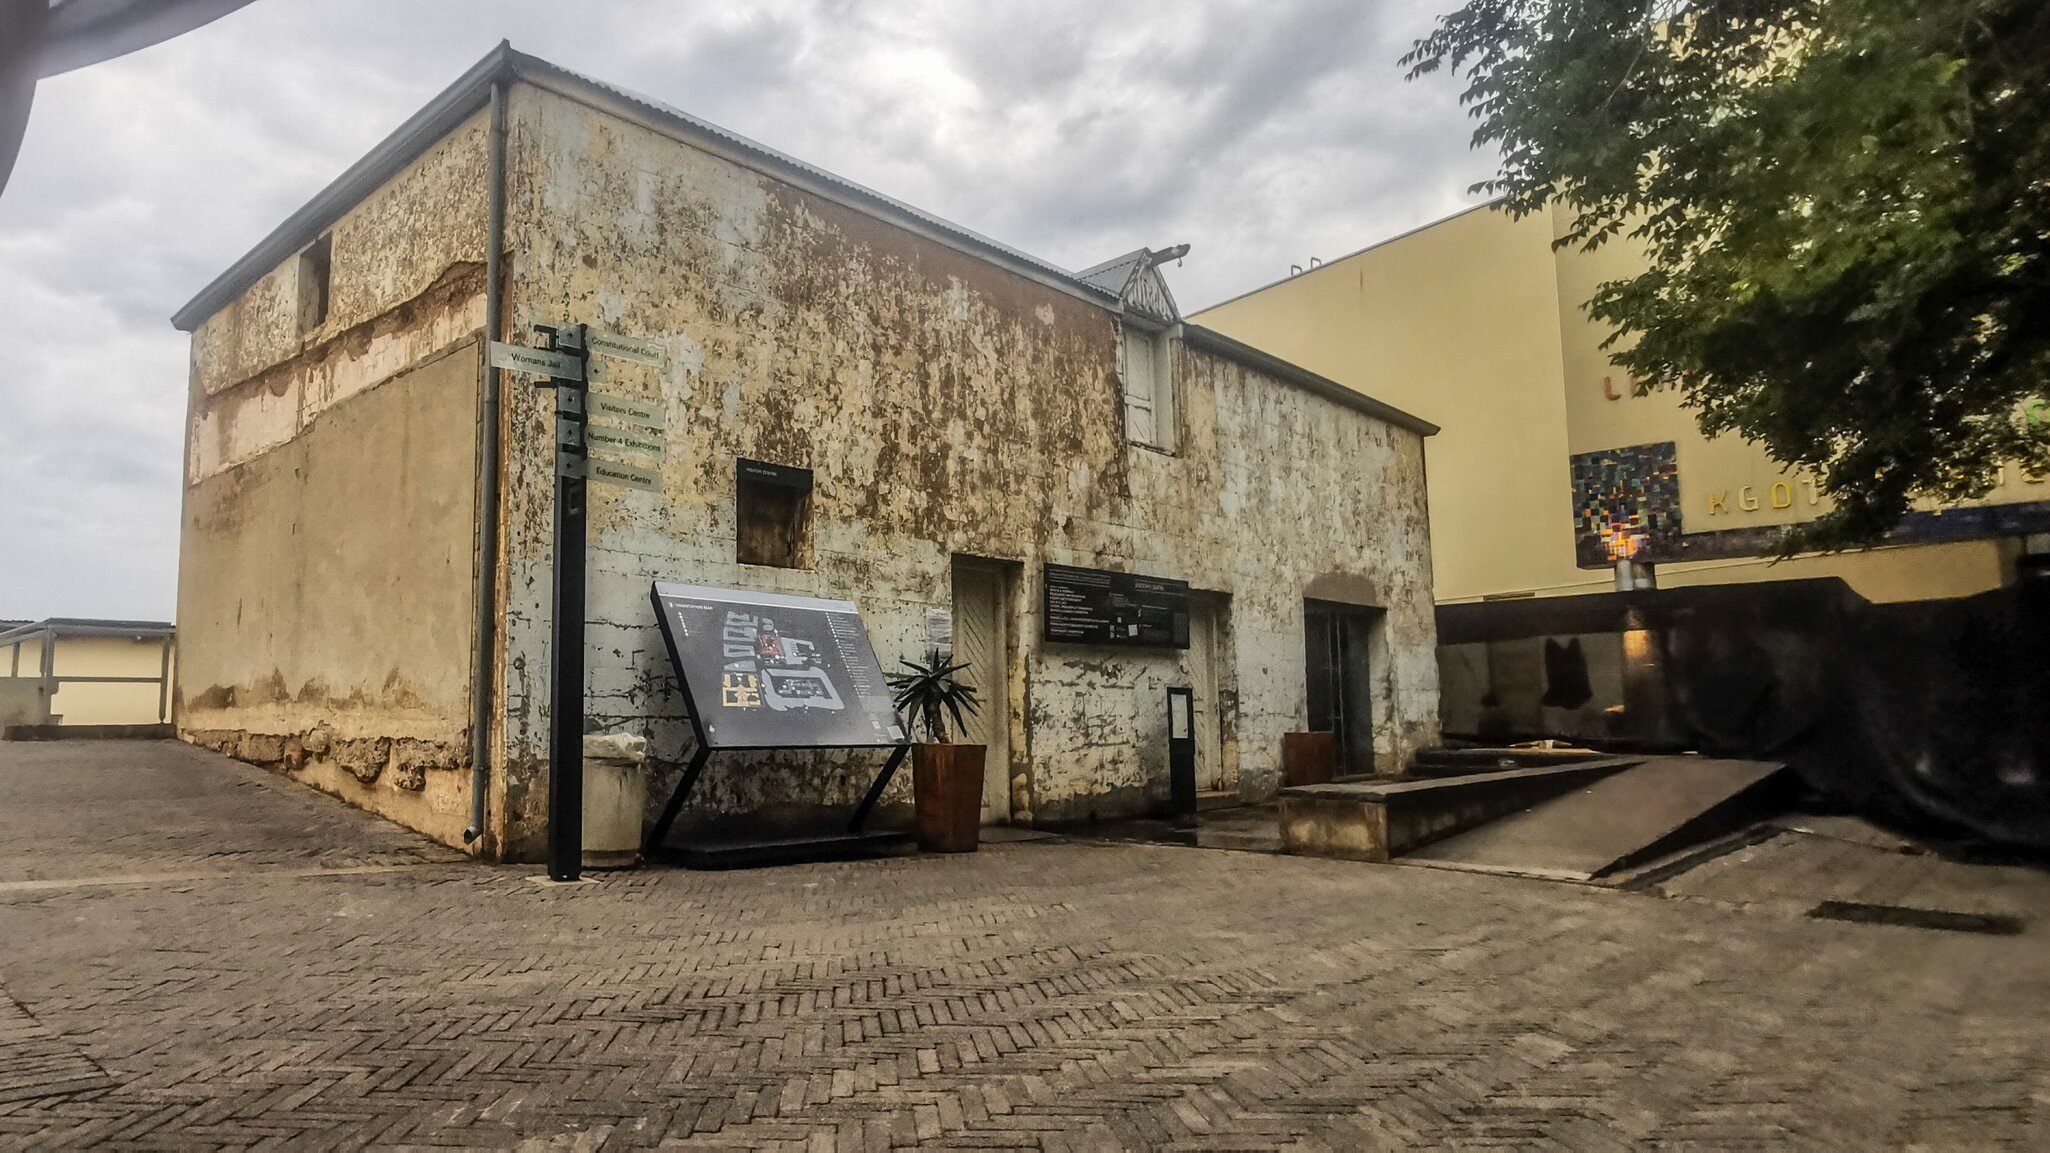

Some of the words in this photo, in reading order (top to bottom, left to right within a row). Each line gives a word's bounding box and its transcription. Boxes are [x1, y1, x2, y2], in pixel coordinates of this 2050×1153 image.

[591, 336, 640, 354] Constitutional
[511, 353, 546, 367] Womans
[600, 402, 628, 414] Visitors
[628, 407, 650, 419] Centre
[588, 432, 617, 444] Number
[624, 437, 661, 452] Exhibitions
[596, 466, 630, 480] Education
[630, 472, 652, 485] Centre
[1709, 477, 1818, 515] KGOT
